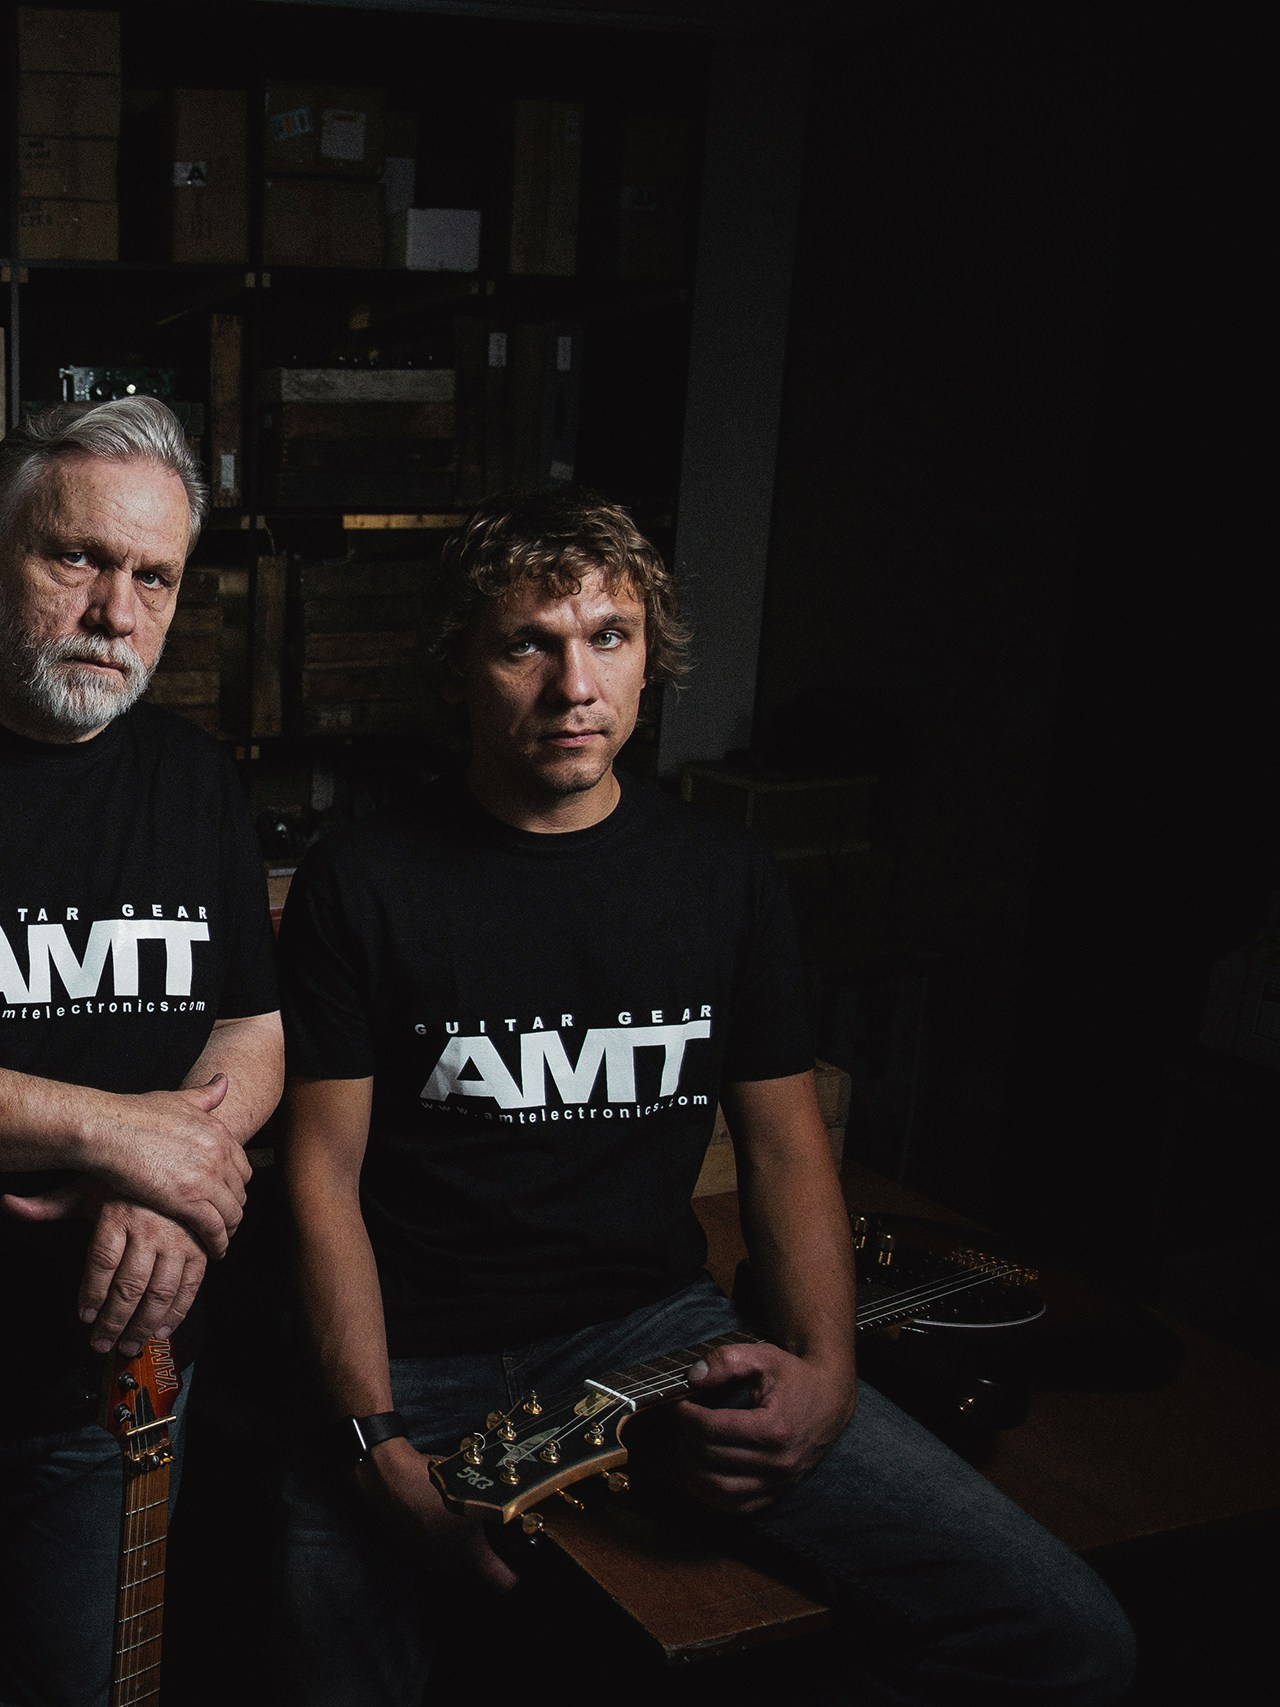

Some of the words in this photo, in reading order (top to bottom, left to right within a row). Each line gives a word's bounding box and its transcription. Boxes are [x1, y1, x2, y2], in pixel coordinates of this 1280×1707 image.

[121, 903, 208, 919] GEAR
[414, 1013, 574, 1036] GUITAR
[617, 1004, 712, 1026] GEAR
[419, 1019, 712, 1110] AMT
[420, 1093, 709, 1124] www.amtelectronics.com
